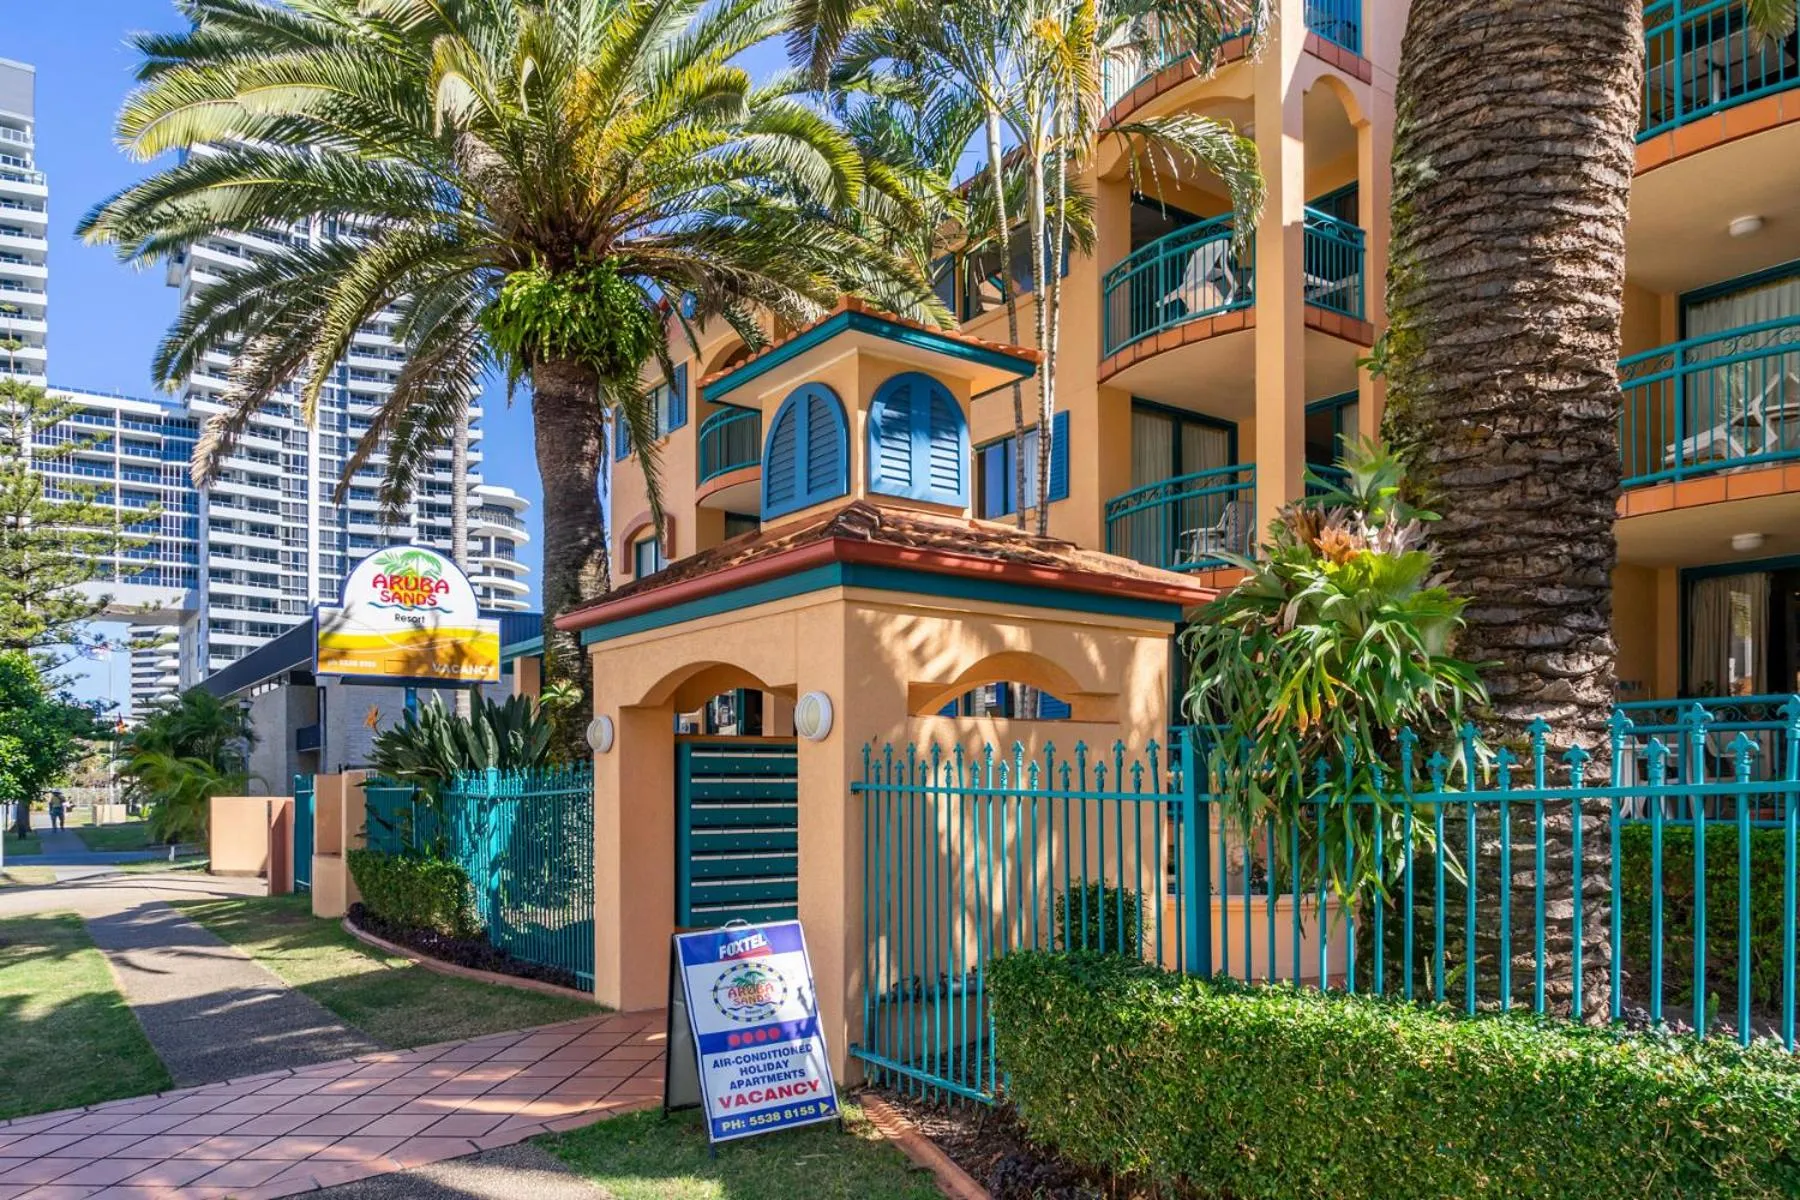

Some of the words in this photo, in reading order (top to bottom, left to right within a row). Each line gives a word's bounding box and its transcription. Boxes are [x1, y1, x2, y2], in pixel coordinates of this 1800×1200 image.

[372, 573, 449, 594] ARUBA
[380, 591, 437, 606] SANDS
[395, 614, 425, 624] Resort
[432, 662, 495, 675] VACANCY
[719, 934, 768, 959] FOXTEL
[728, 982, 774, 998] ARUBA
[733, 994, 772, 1006] SANDS
[713, 1043, 813, 1069] AIR-CONDITIONED
[740, 1059, 789, 1076] HOLIDAY
[729, 1069, 806, 1090] APARTMENTS
[718, 1079, 820, 1109] VACANCY
[722, 1119, 745, 1131] PH:
[749, 1114, 781, 1126] 5538
[785, 1105, 815, 1119] 8155
